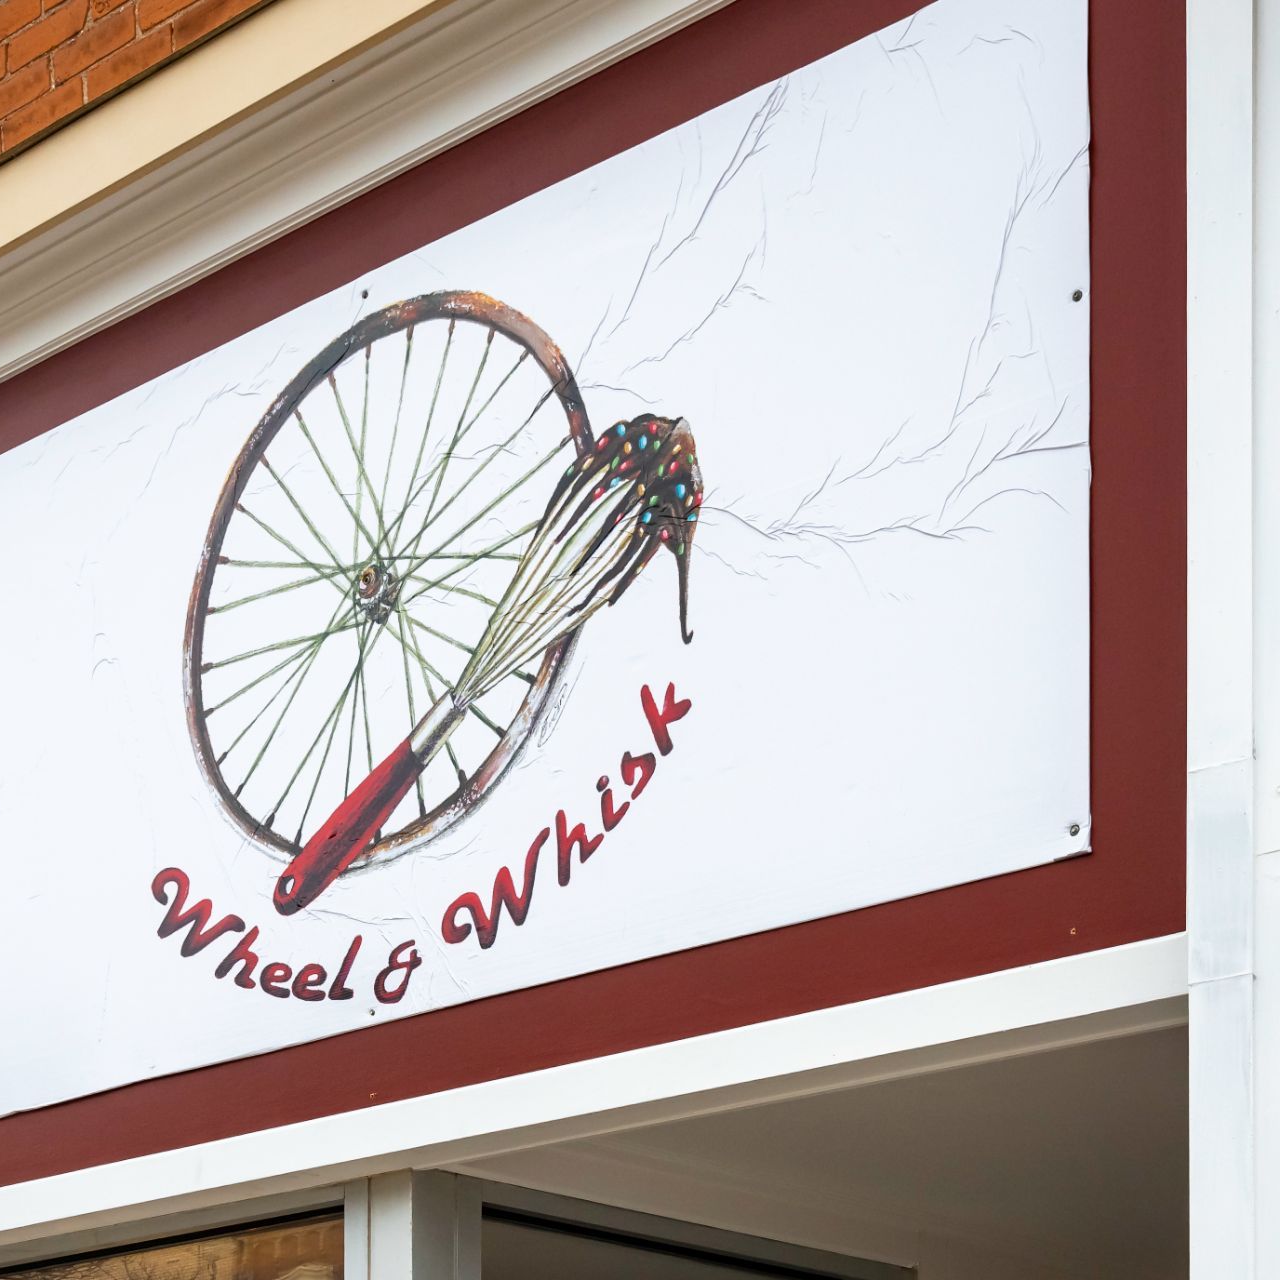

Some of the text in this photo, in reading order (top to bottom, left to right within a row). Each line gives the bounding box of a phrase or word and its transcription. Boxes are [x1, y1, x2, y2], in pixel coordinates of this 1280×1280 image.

[151, 682, 691, 1003] Wheel & Whisk
